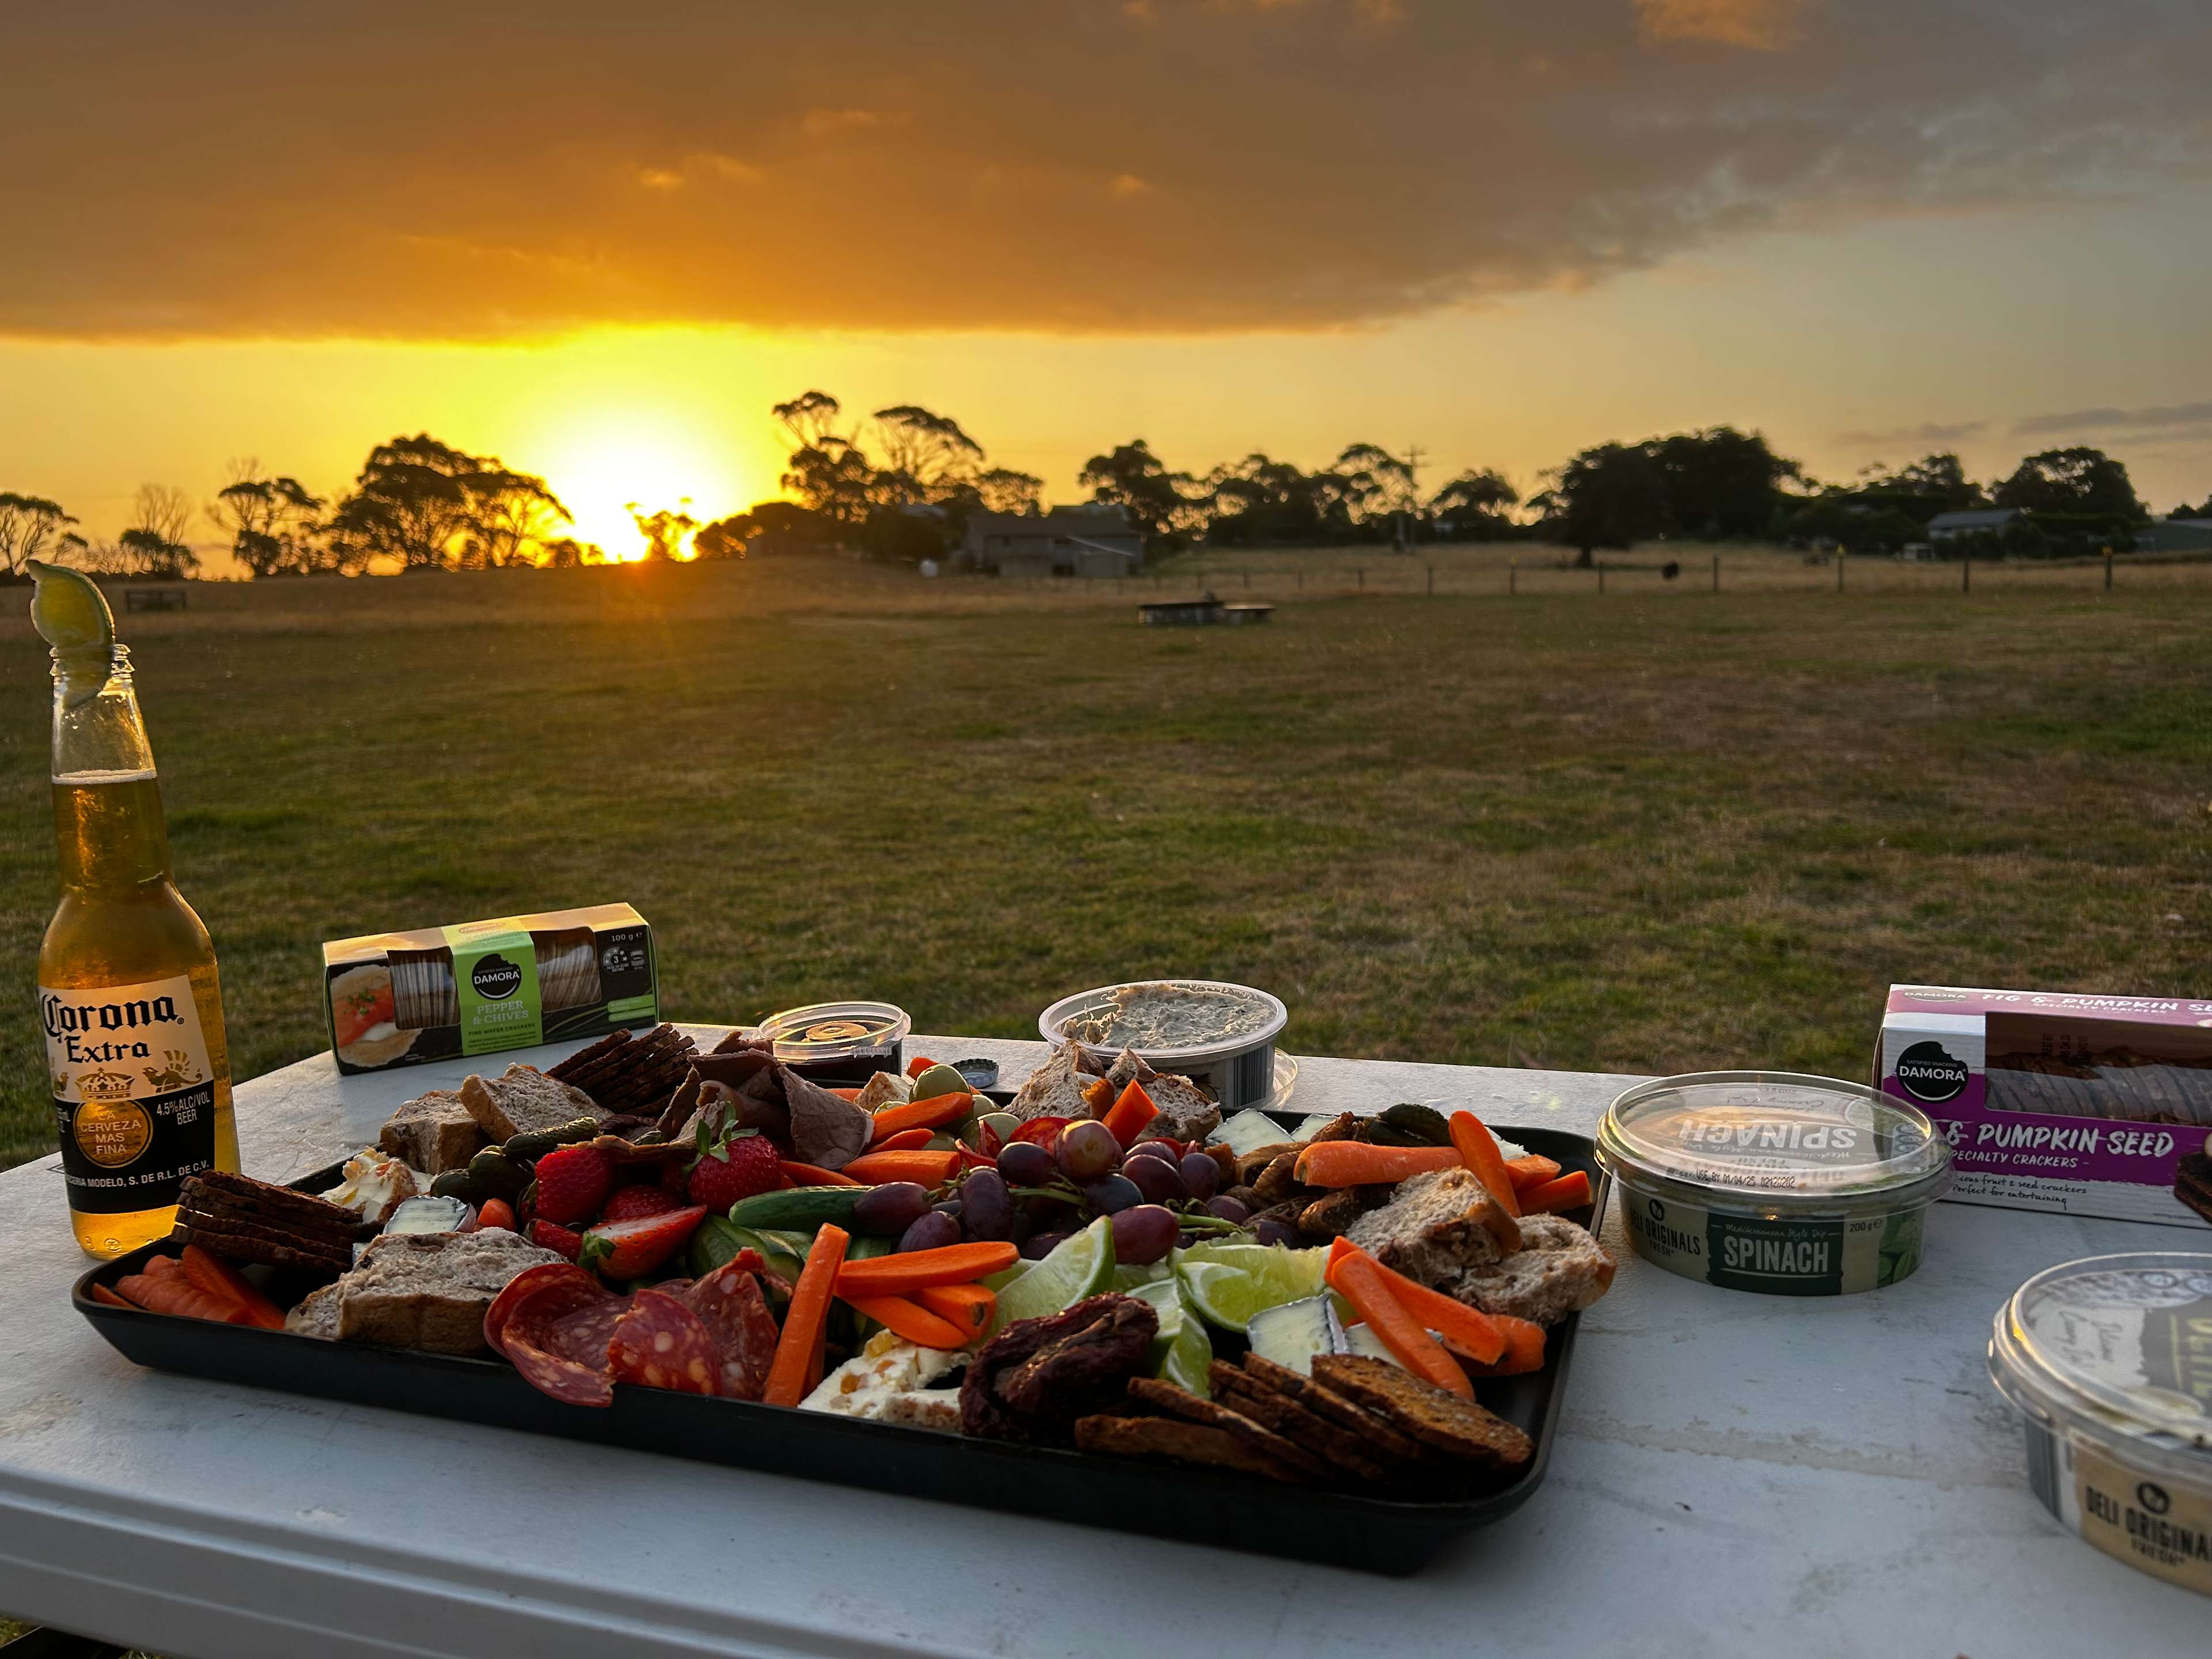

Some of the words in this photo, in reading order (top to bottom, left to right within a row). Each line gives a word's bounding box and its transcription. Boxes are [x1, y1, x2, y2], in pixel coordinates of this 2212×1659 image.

[611, 934, 626, 942] 100
[613, 956, 619, 964] 3
[474, 971, 520, 984] DAMORA
[478, 1000, 524, 1014] PEPPER
[2062, 998, 2179, 1010] PUMPKIN
[42, 994, 179, 1043] Corona
[473, 1016, 482, 1025] &
[484, 1010, 529, 1024] CHIVES
[65, 1036, 151, 1063] Extra
[1899, 1066, 1965, 1081] DAMORA
[177, 1109, 197, 1125] BEER
[80, 1120, 142, 1132] CERVEZA
[96, 1132, 125, 1143] MAS
[1677, 1119, 1857, 1149] SPINACH
[1946, 1121, 1969, 1146] &
[1977, 1123, 2099, 1154] PUMPKIN
[2107, 1131, 2174, 1157] SEED
[96, 1144, 127, 1155] FINA
[1952, 1150, 2008, 1164] PECIALTY
[2013, 1153, 2078, 1168] CRACKERS
[88, 1177, 127, 1188] MODELO,
[128, 1176, 138, 1185] S.
[141, 1173, 154, 1184] DE
[157, 1170, 176, 1181] R.L.
[179, 1165, 191, 1176] DE
[193, 1160, 209, 1172] C.V.
[1712, 1172, 1720, 1181] BY
[1983, 1175, 2006, 1185] fruit
[2018, 1181, 2039, 1190] seed
[2041, 1184, 2087, 1194] crackers
[1953, 1184, 1986, 1195] Perfect
[1990, 1186, 2005, 1196] for
[2008, 1192, 2067, 1211] entertaining
[1725, 1223, 1786, 1237] Mediterranean
[1812, 1230, 1825, 1238] Dip
[1850, 1222, 1866, 1233] 200
[1646, 1217, 1700, 1255] ORIGINALS
[1724, 1236, 1829, 1273] SPINACH
[2086, 1484, 2119, 1525] DELI
[2126, 1506, 2212, 1563] ORIGINA
